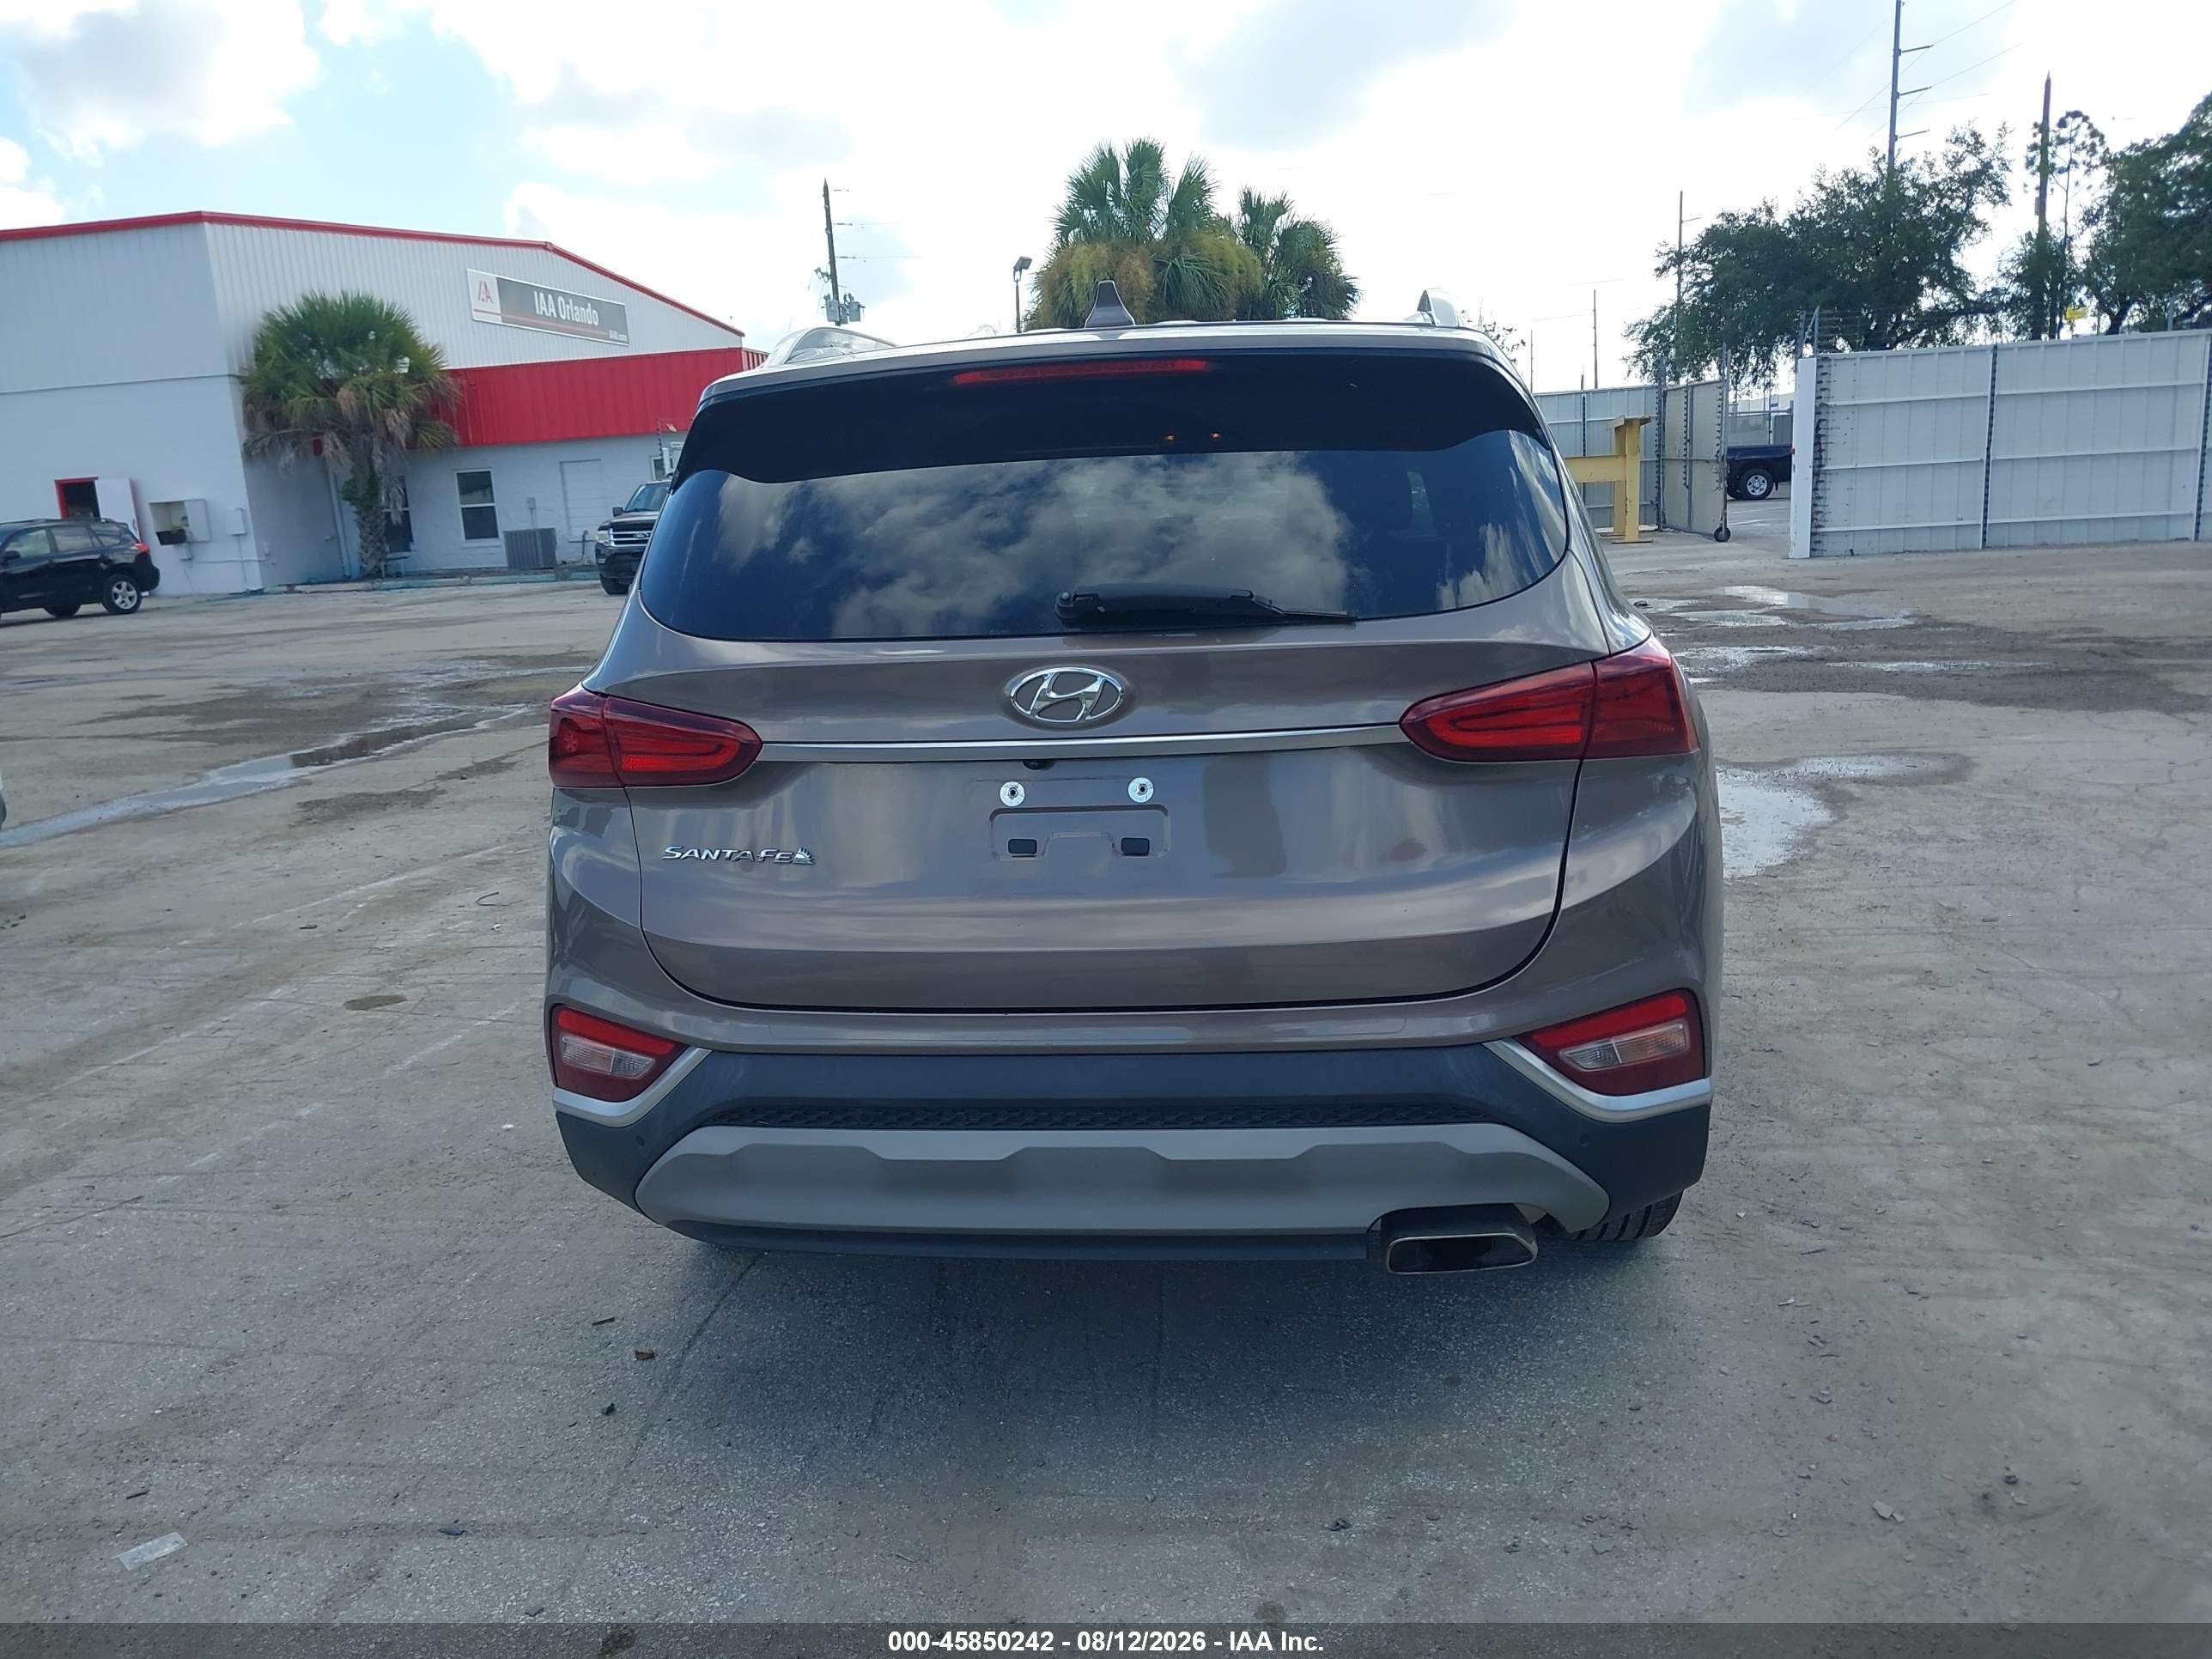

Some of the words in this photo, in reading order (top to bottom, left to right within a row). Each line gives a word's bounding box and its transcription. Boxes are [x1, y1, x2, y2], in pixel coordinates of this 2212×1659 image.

[533, 291, 557, 319] IAA
[559, 296, 599, 326] Orlando
[662, 846, 756, 862] SANTA
[757, 848, 793, 864] FE
